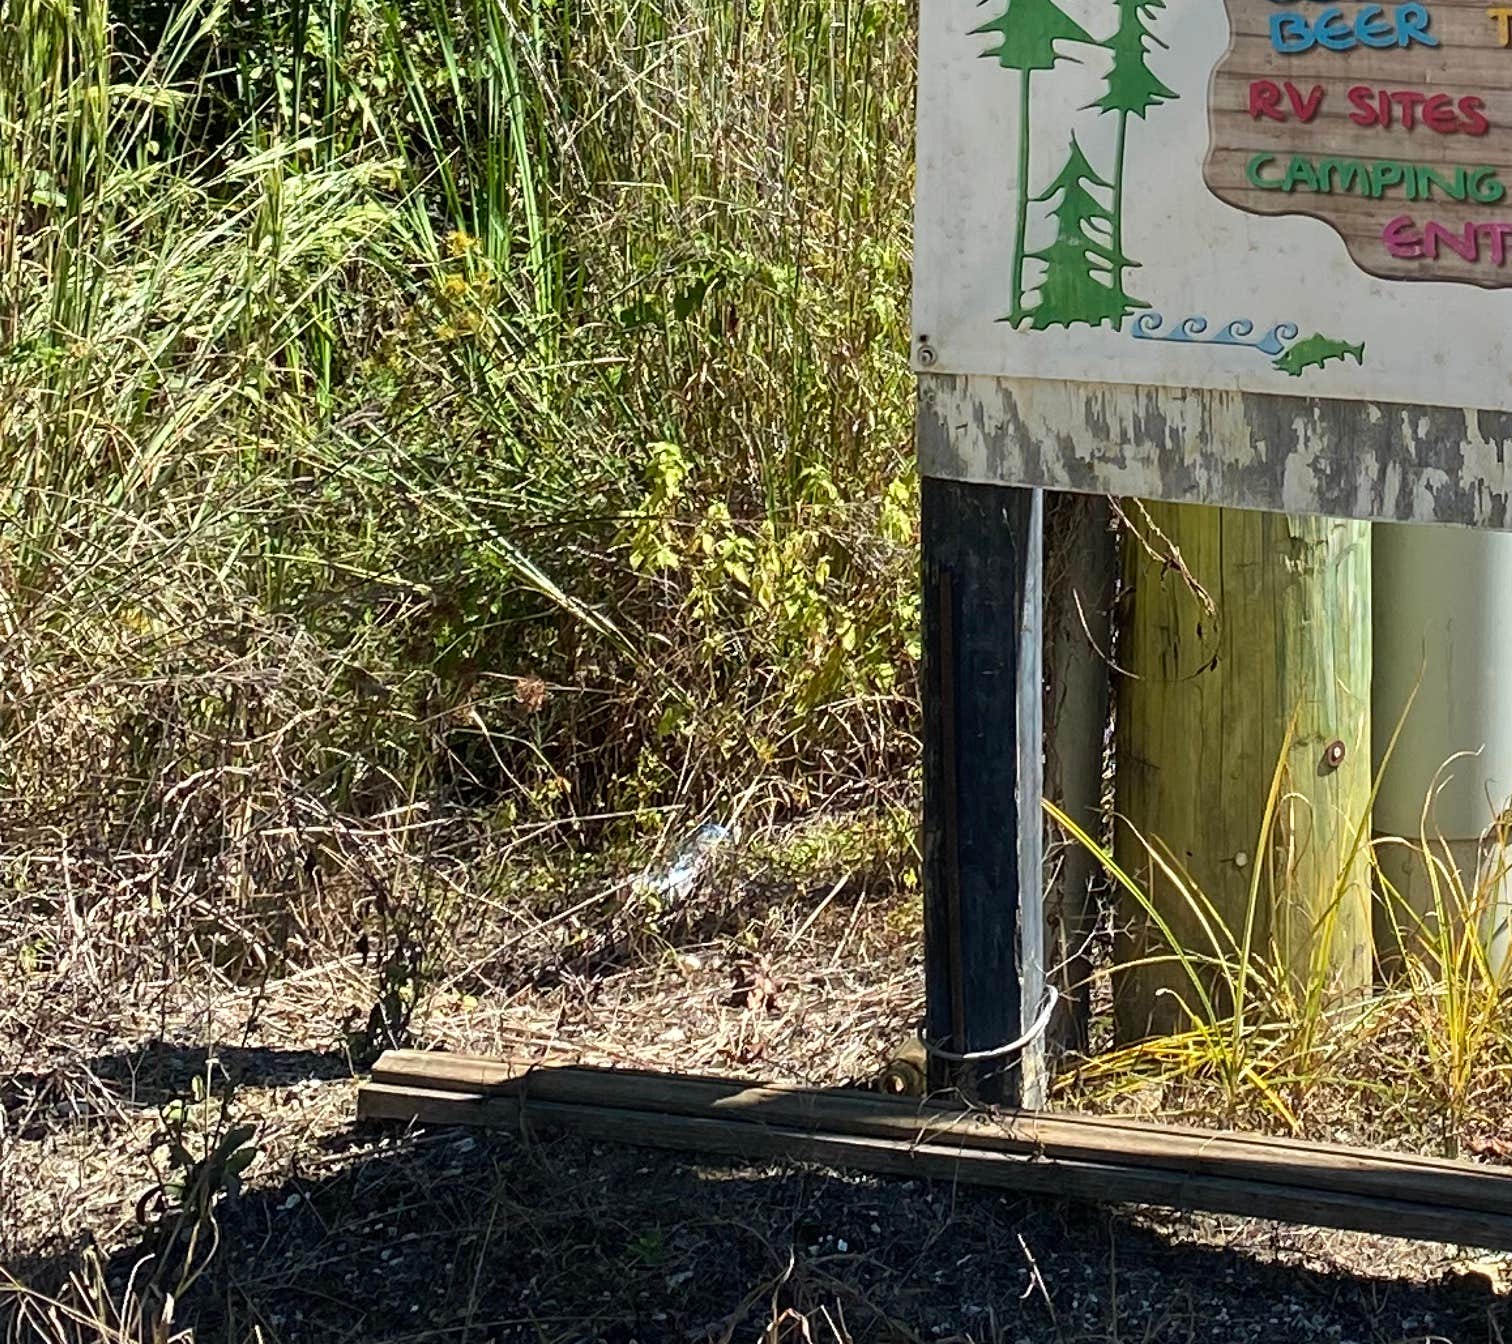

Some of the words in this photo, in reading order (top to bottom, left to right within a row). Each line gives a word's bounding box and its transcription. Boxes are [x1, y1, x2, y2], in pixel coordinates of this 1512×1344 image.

[1269, 5, 1439, 54] BEER
[1248, 79, 1325, 124] RV
[1347, 85, 1490, 136] SITES
[1246, 151, 1507, 204] CAMPING
